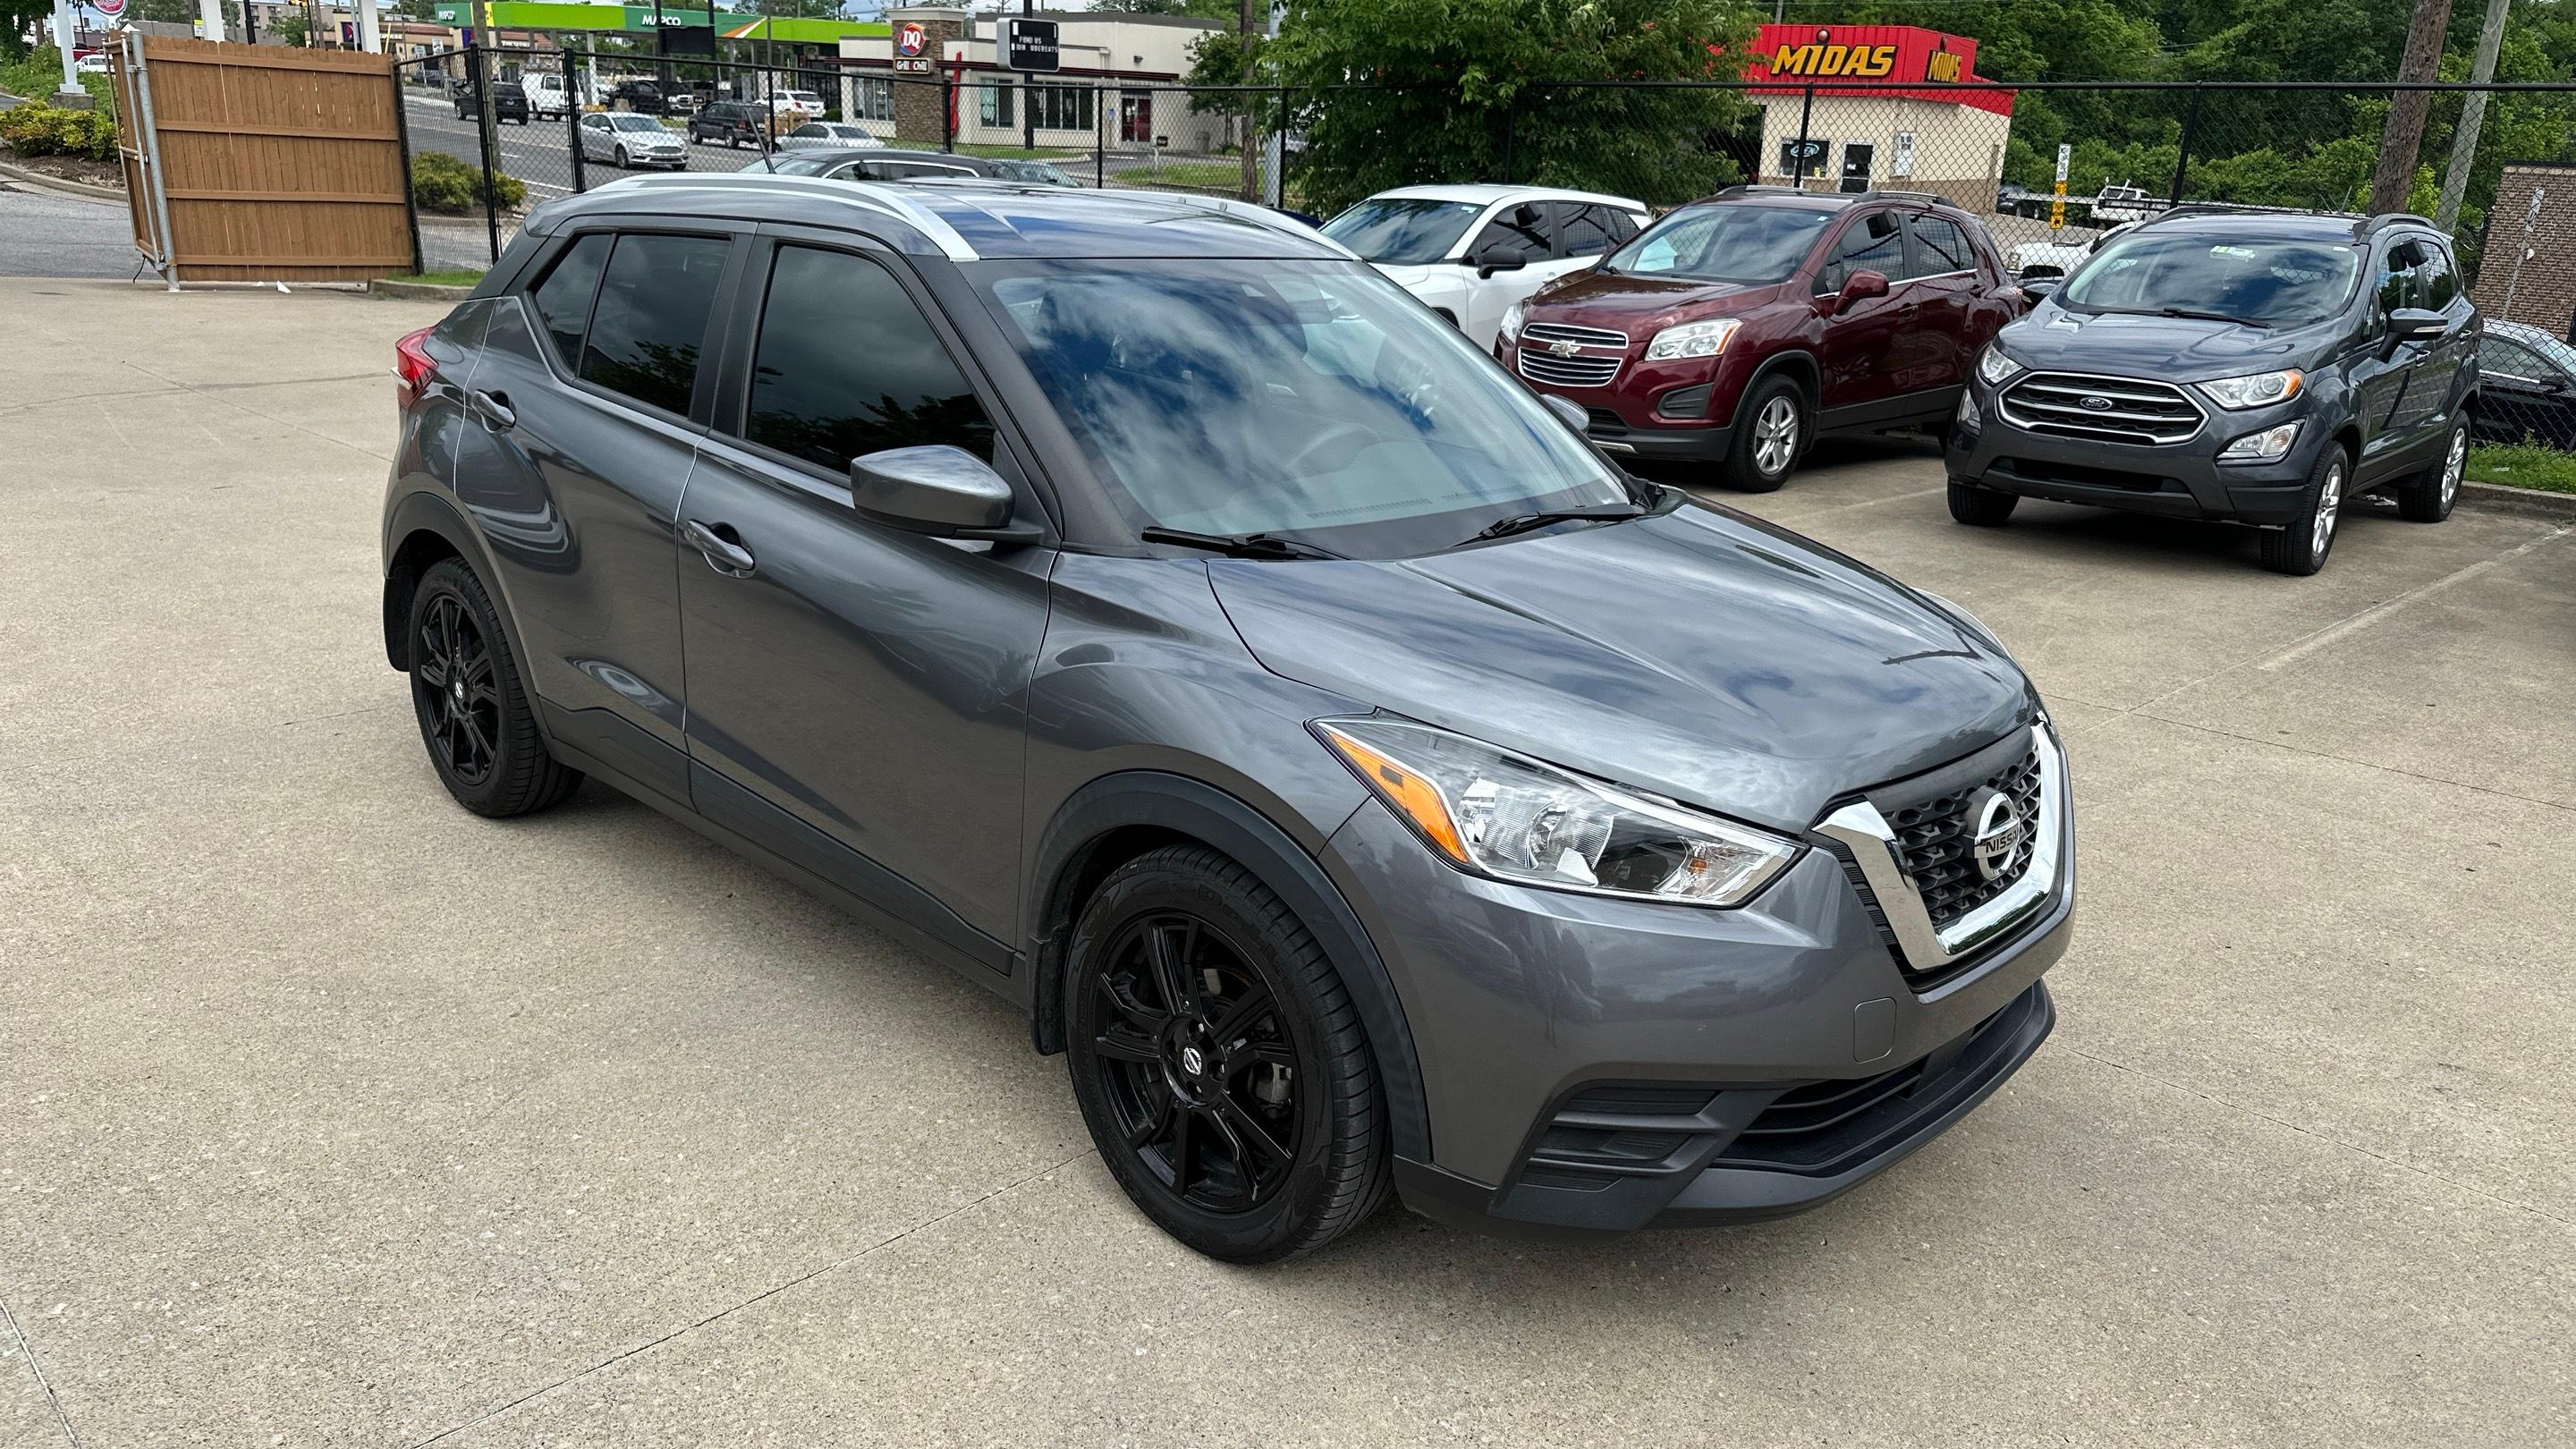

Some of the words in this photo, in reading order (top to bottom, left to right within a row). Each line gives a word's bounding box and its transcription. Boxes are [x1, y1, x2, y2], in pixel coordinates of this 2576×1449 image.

[903, 30, 921, 49] DQ
[1771, 46, 1895, 75] MIDAS
[1928, 51, 1962, 82] MIDAS
[1985, 828, 2019, 853] NISSA
